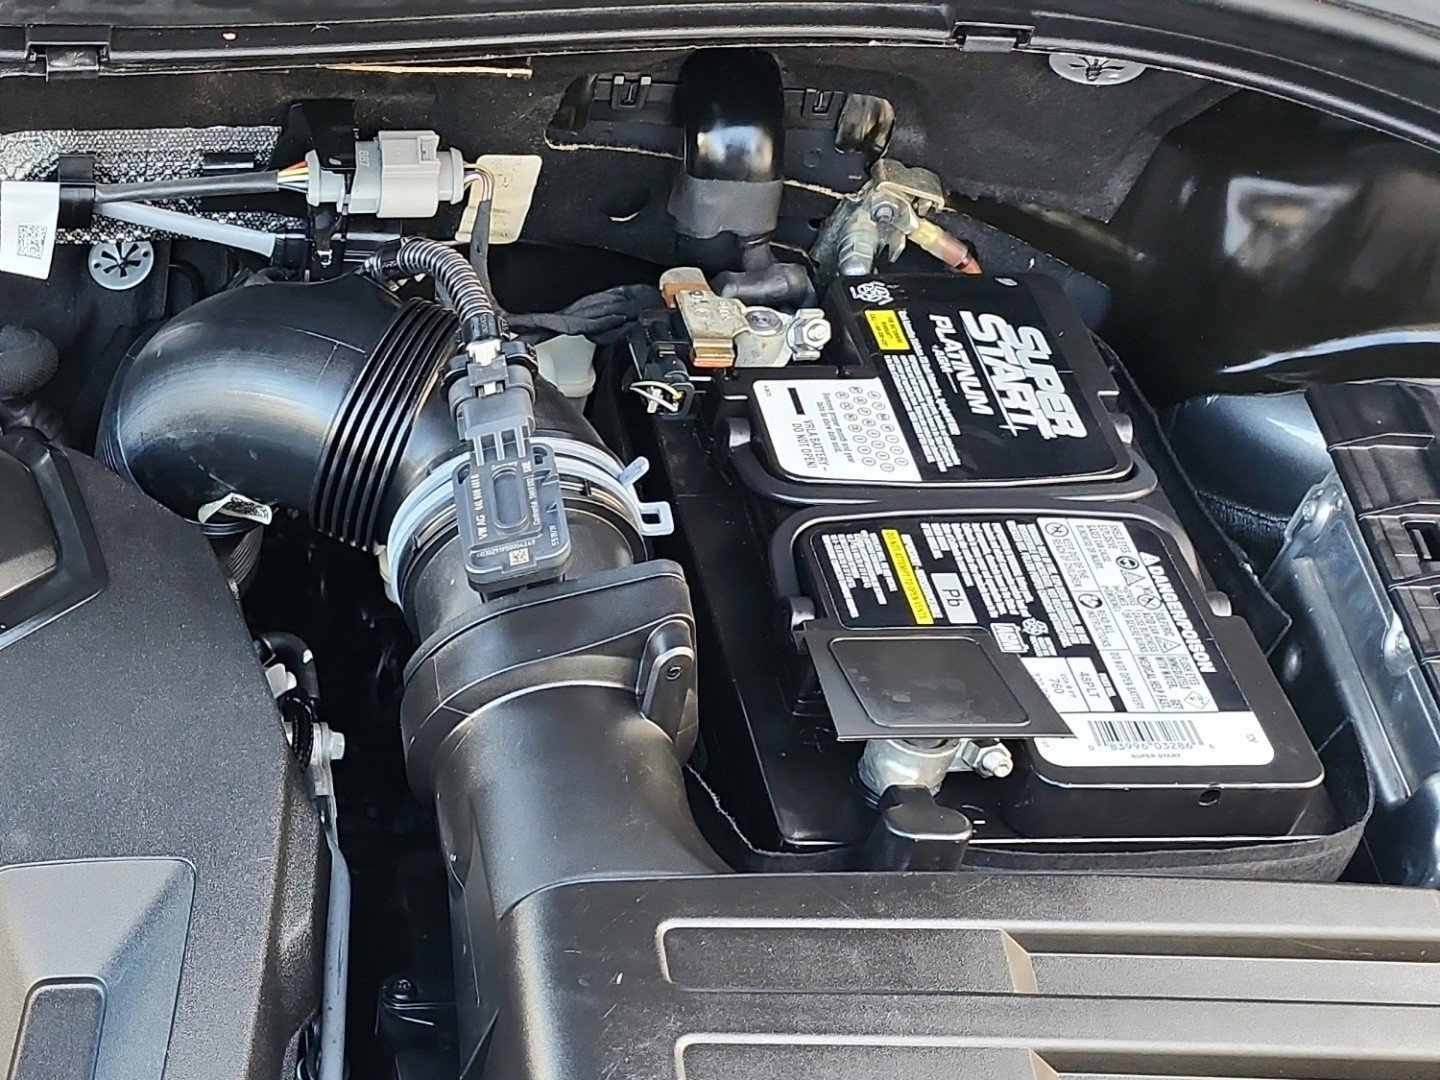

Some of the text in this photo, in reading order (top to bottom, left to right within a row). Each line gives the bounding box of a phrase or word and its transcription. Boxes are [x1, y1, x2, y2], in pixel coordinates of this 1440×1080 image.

[929, 314, 995, 415] PLATINUM
[933, 347, 954, 373] AGM
[959, 311, 1058, 440] START
[1006, 325, 1088, 438] SUPER
[790, 424, 804, 432] DO
[801, 420, 818, 436] VRLA
[794, 434, 809, 447] NOT
[807, 438, 830, 466] BATTERY
[475, 515, 487, 526] AG
[478, 527, 488, 540] VW
[942, 589, 963, 607] Pb
[1148, 566, 1218, 672] DANGER/POISON
[1108, 652, 1121, 660] DO
[1112, 661, 1127, 671] NOT
[1118, 673, 1134, 685] OPEN
[1136, 657, 1157, 679] MEDICAL
[1148, 680, 1164, 693] HELP
[1154, 741, 1194, 751] 03286
